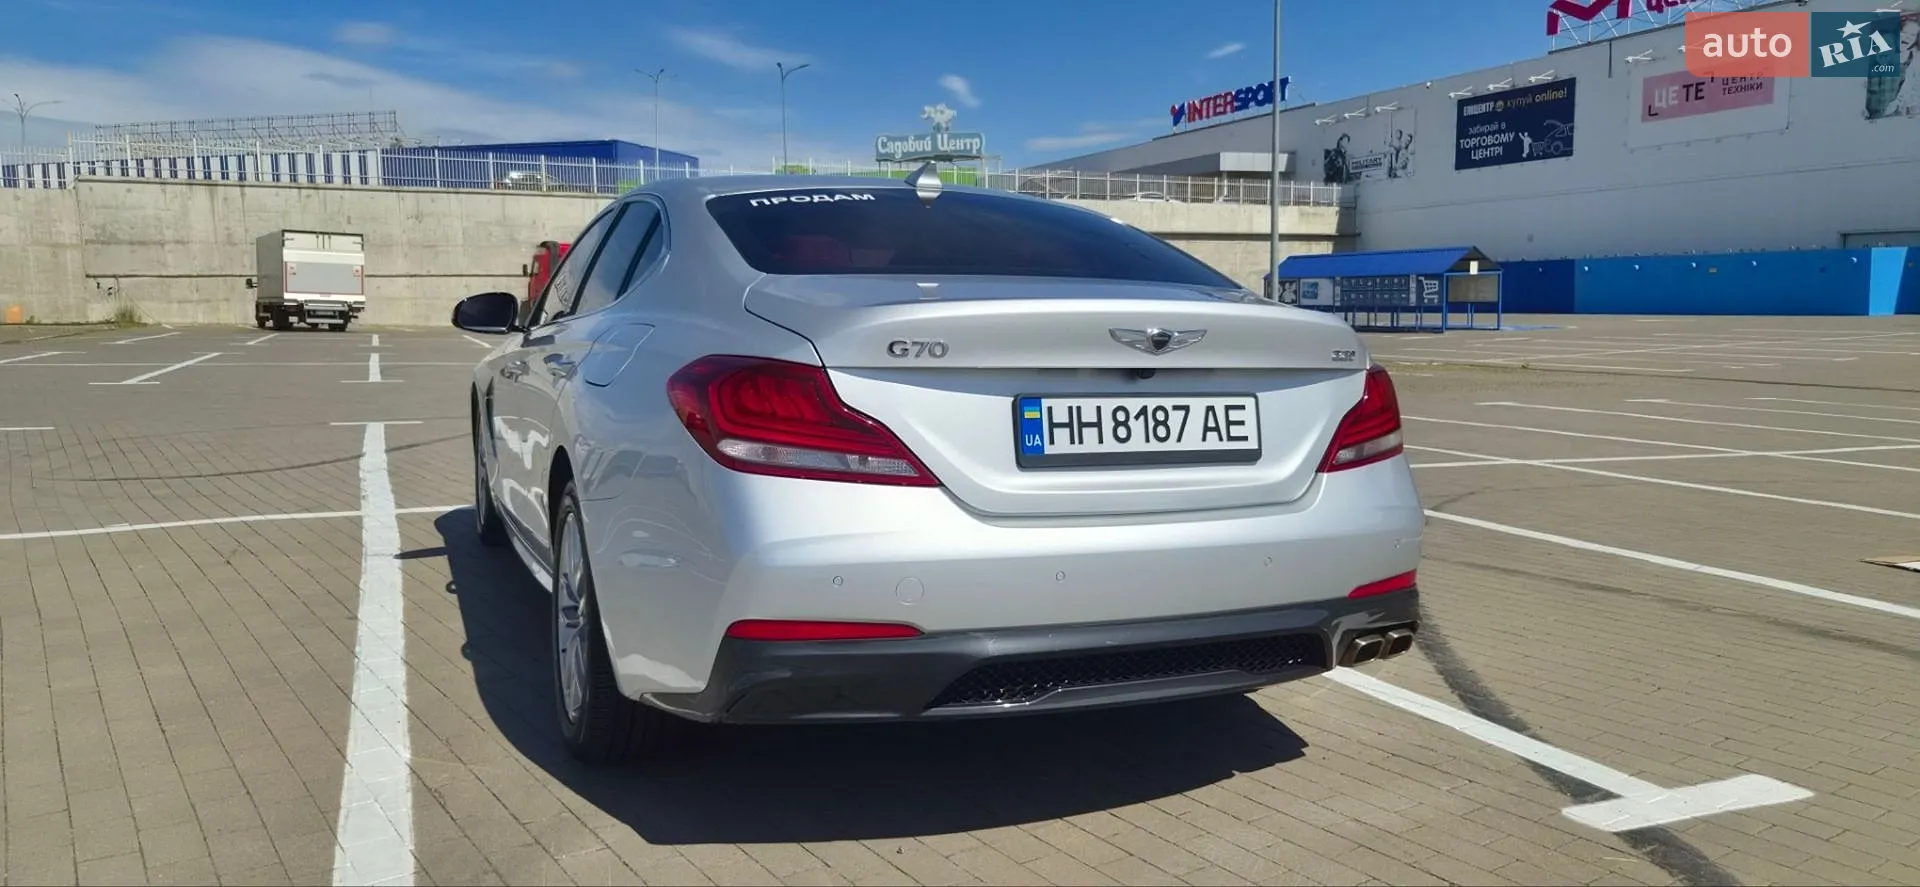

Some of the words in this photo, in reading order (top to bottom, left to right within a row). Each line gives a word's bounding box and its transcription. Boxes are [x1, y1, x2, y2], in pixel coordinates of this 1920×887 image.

[1535, 87, 1568, 102] online!
[1722, 81, 1763, 96] ТЕХНІКИ
[1468, 121, 1499, 135] забирай
[937, 133, 981, 154] Центр
[1460, 132, 1515, 149] ТОРГОВОМУ
[1471, 146, 1503, 160] ЦЕНТРІ
[749, 193, 876, 207] ПРОДАМ
[886, 340, 949, 358] G70
[1047, 405, 1104, 445] HH
[1111, 404, 1191, 443] 8187
[1201, 404, 1249, 443] AE
[1025, 433, 1042, 447] UA
